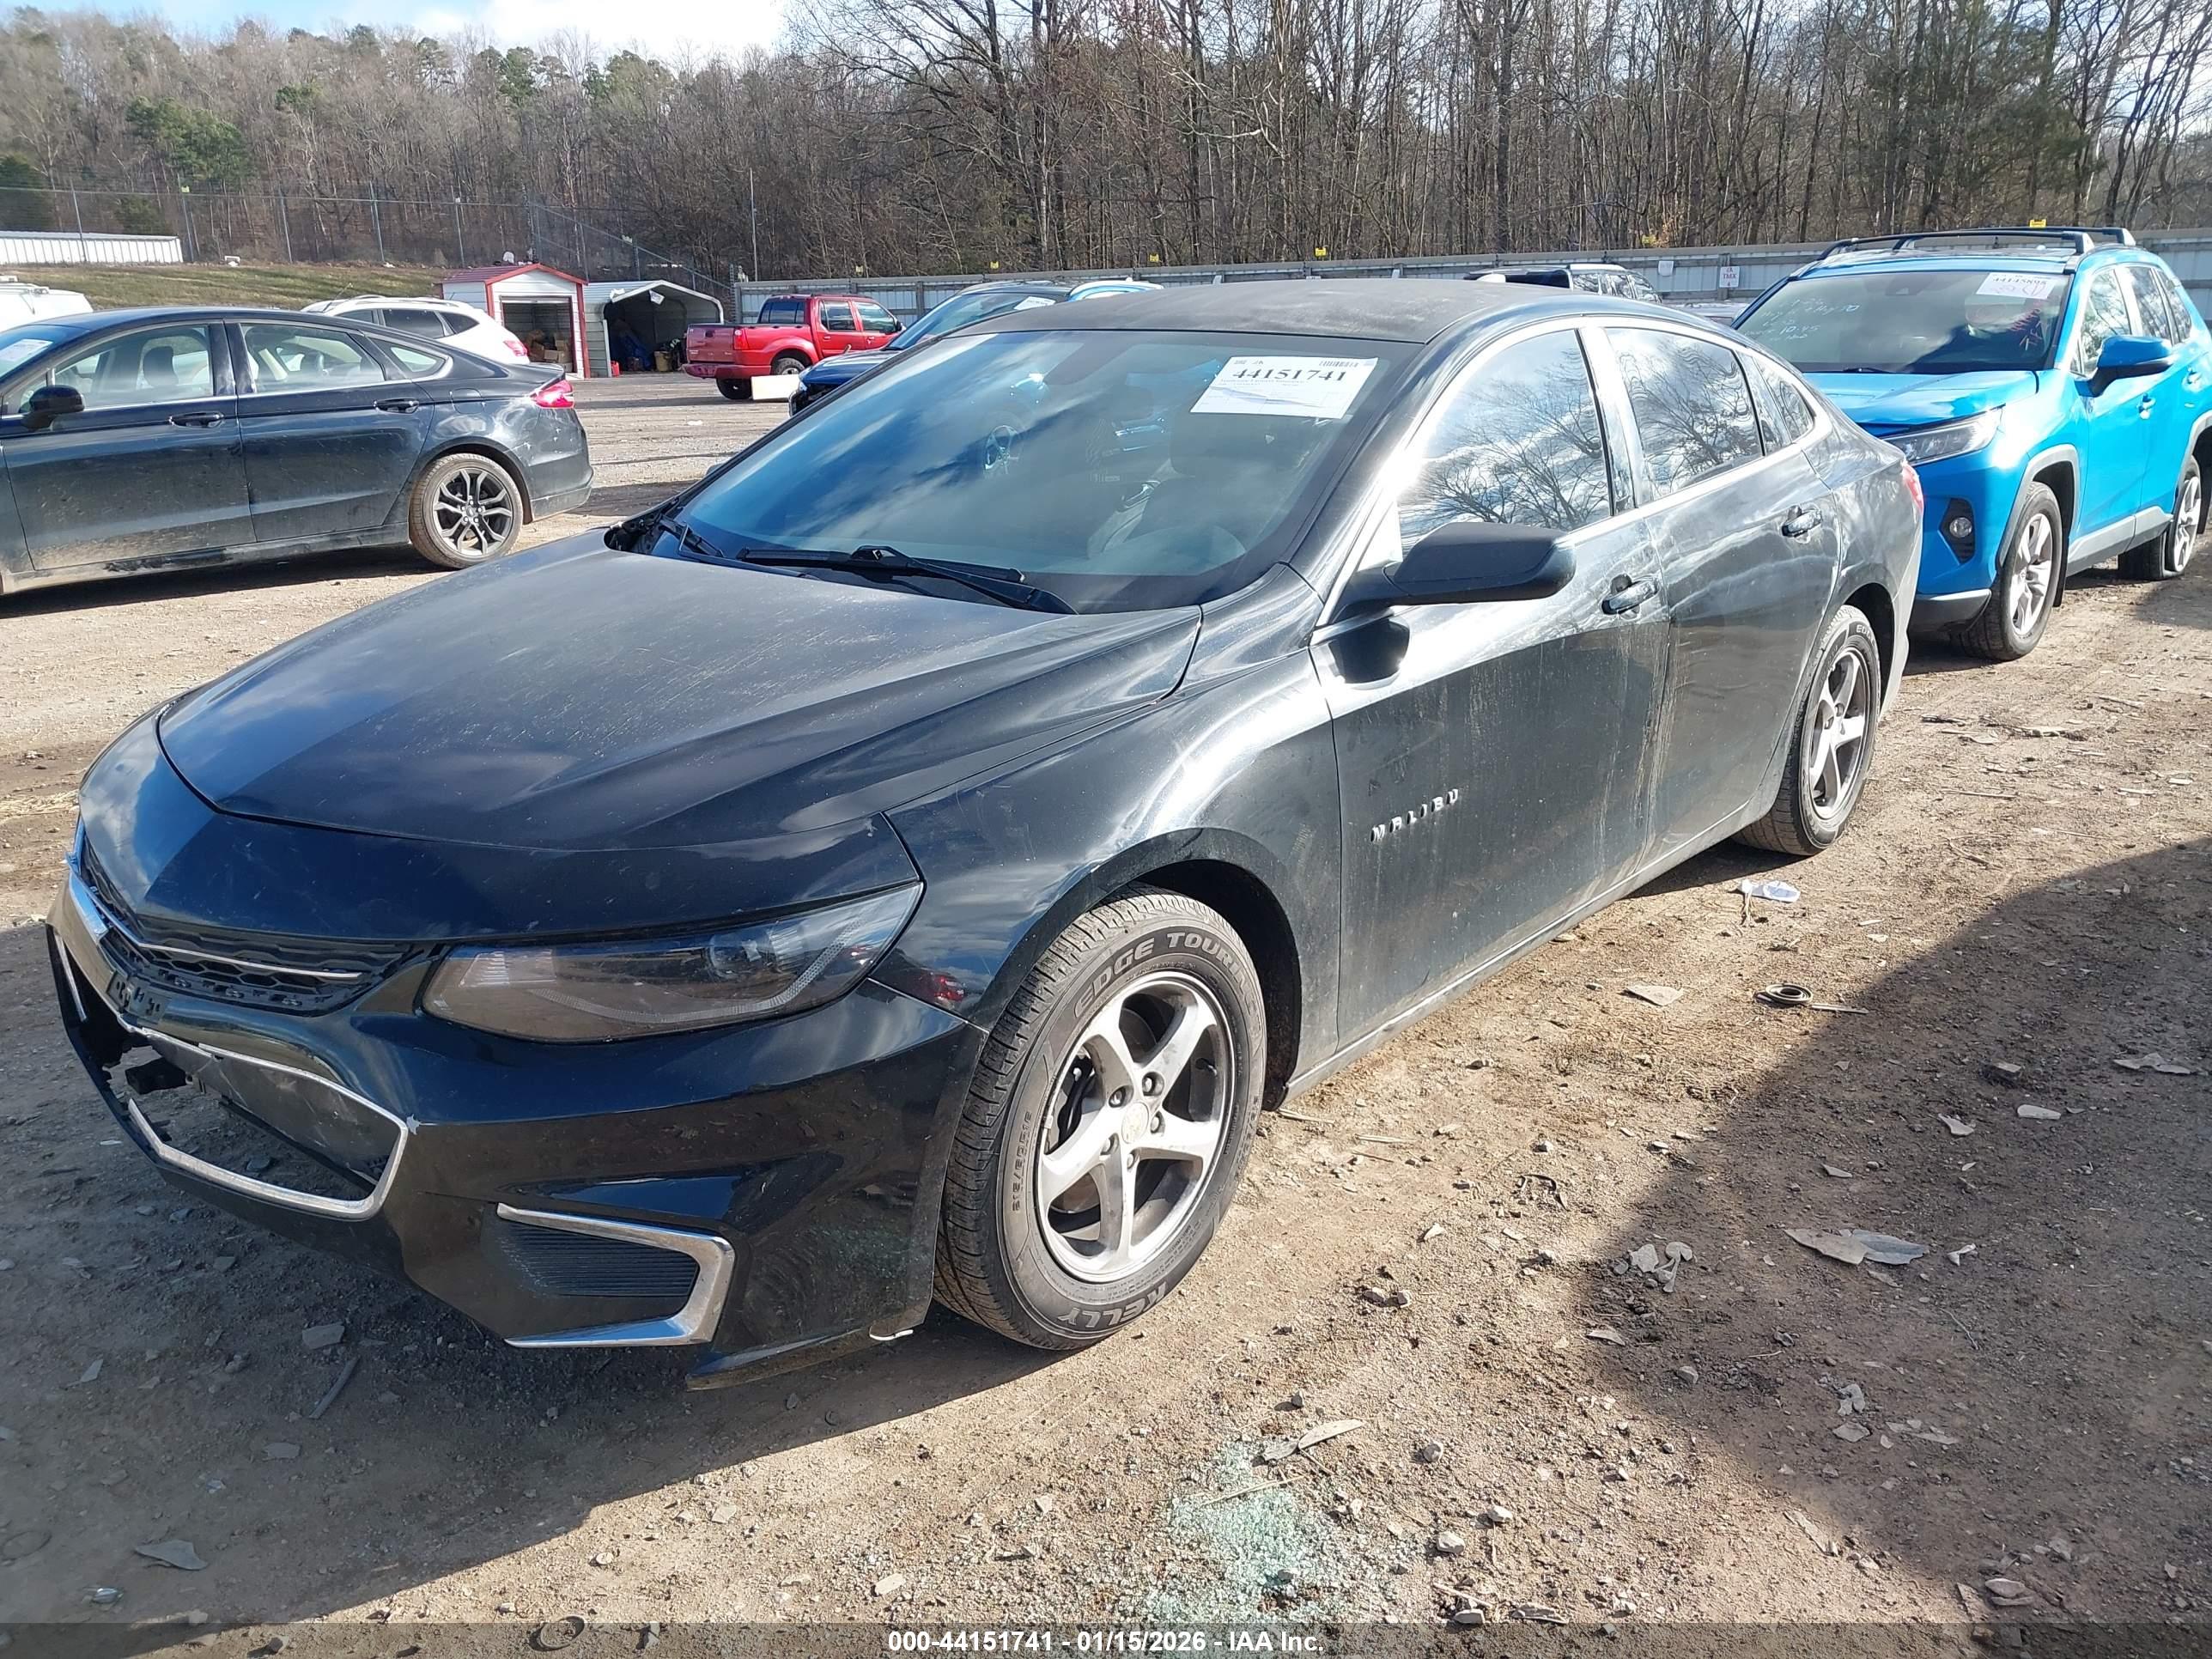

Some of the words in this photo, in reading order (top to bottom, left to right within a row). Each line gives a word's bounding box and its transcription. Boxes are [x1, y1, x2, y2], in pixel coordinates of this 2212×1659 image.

[1232, 368, 1347, 381] 44151741
[1370, 788, 1459, 842] MALIBU
[1074, 937, 1155, 1018] EDGE
[1057, 1281, 1167, 1328] KELLY
